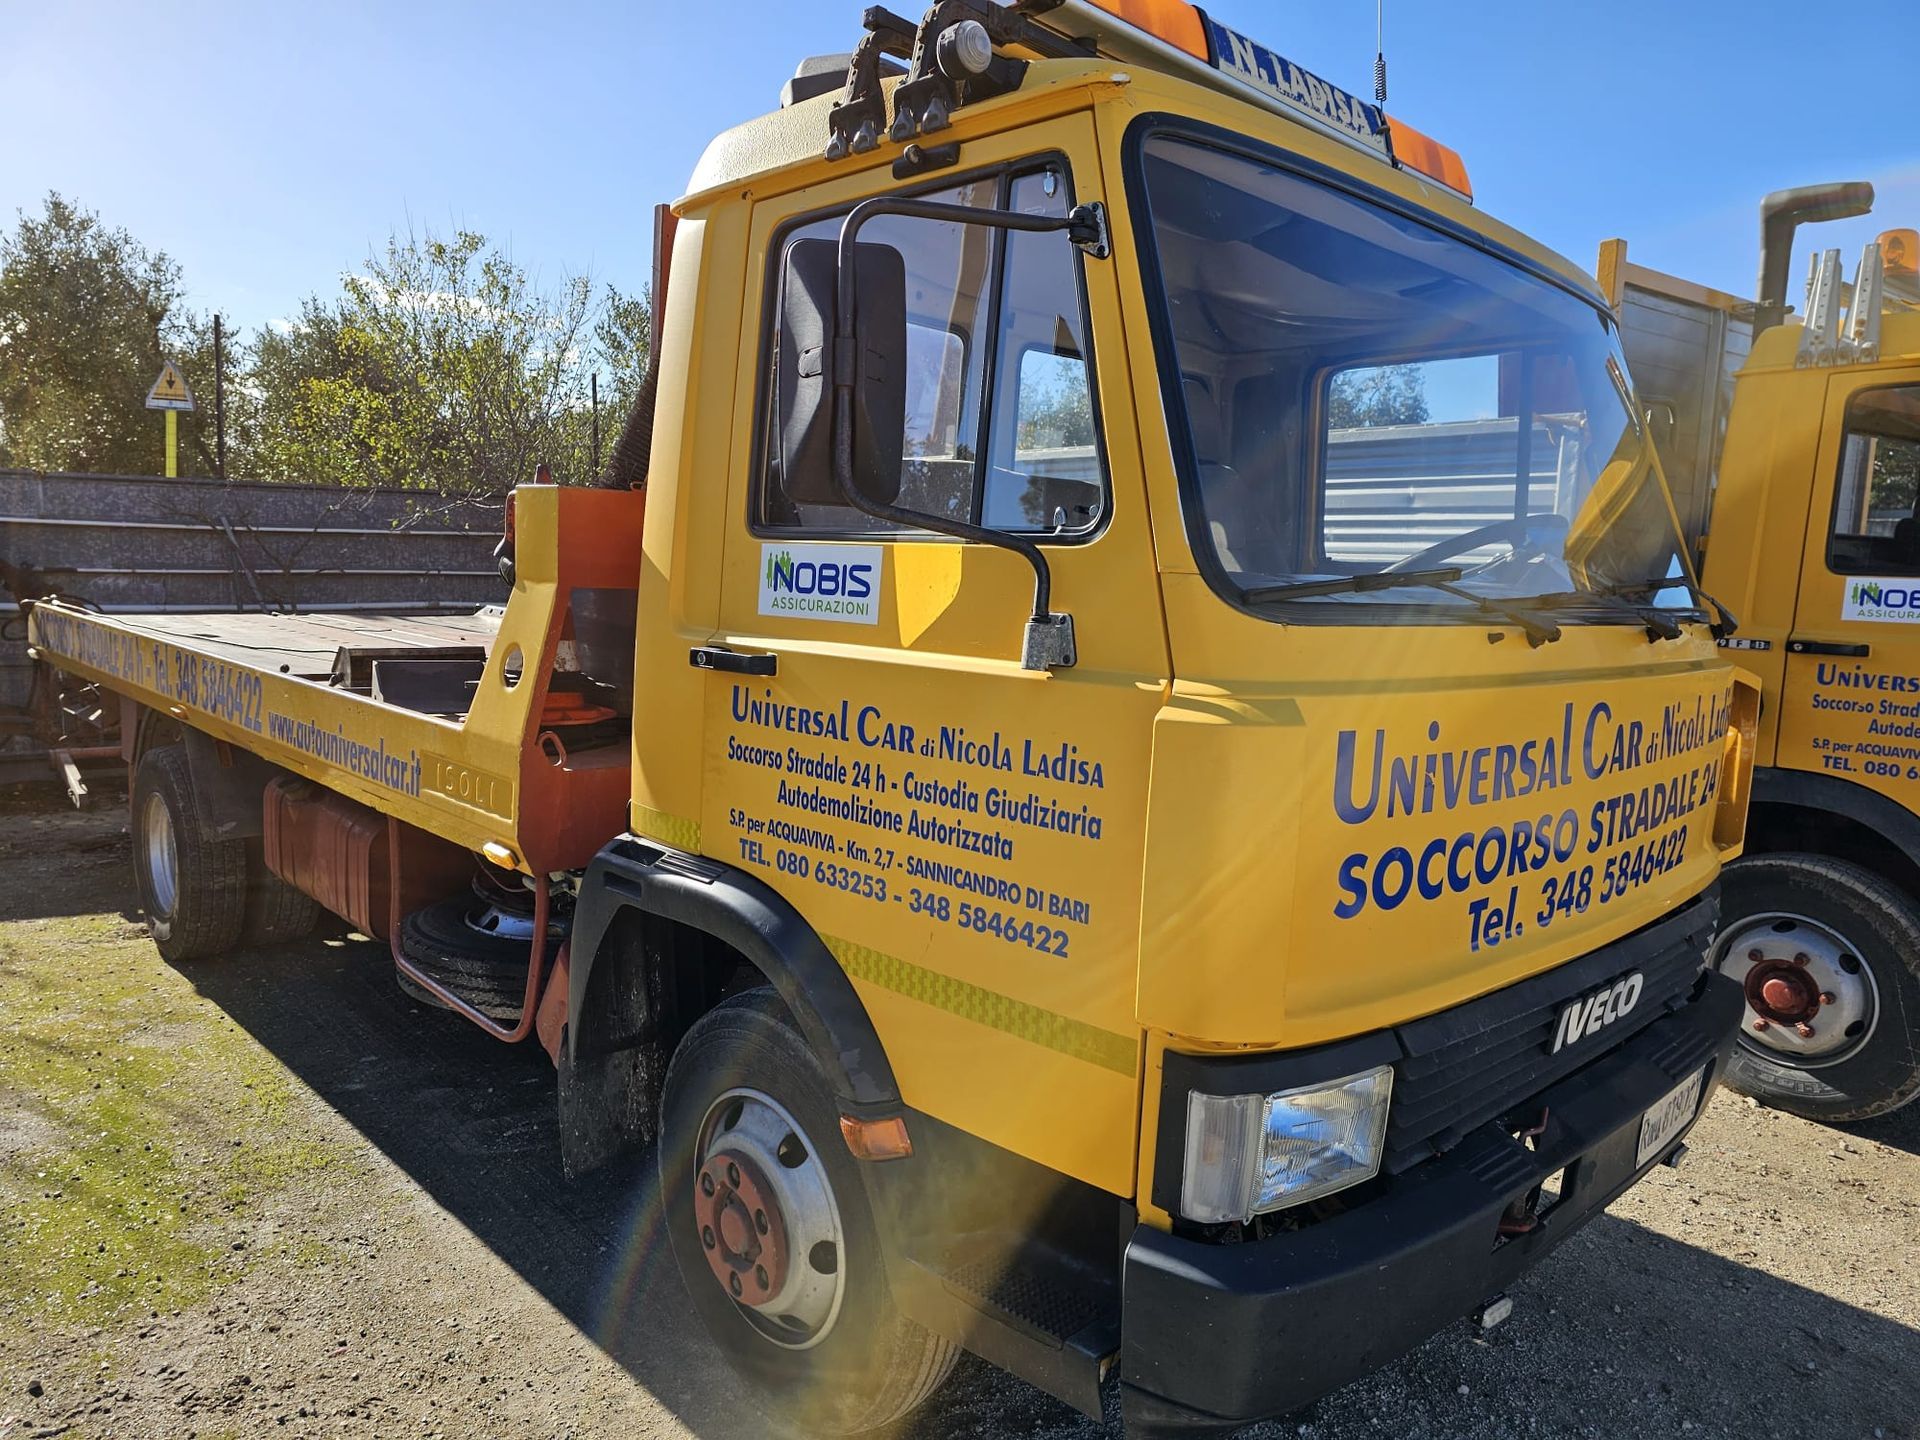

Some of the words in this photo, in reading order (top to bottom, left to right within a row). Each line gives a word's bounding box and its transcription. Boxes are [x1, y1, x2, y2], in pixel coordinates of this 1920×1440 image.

[1269, 53, 1373, 134] LADISA
[771, 597, 869, 616] ASSICURAZIONI
[774, 561, 872, 598] NOBIS
[176, 651, 198, 706] 348
[201, 658, 262, 734] 5846422
[1812, 694, 1874, 713] Soccorso
[268, 712, 421, 798] www.autouniversalcar.it
[436, 763, 494, 808] ISOLI
[920, 737, 935, 759] di
[1646, 732, 1659, 764] di
[1812, 738, 1830, 750] S.P.
[1833, 742, 1853, 753] per
[1822, 755, 1857, 772] TEL.
[1864, 761, 1900, 777] 080
[728, 735, 782, 771] Soccorso
[787, 748, 847, 784] Stradale
[851, 760, 871, 789] 24
[875, 768, 886, 793] h
[903, 771, 979, 814] Custodia
[984, 787, 1102, 839] Giudiziaria
[777, 779, 903, 833] Autodemolizione
[907, 810, 1014, 860] Autorizzata
[729, 808, 745, 829] S.P.
[747, 817, 766, 837] per
[767, 820, 836, 854] ACQUAVIVA
[846, 840, 871, 864] Km.
[874, 847, 895, 871] 2,7
[906, 855, 1021, 905] SANNICANDRO
[1026, 887, 1045, 911] DI
[1049, 894, 1090, 925] BARI
[1333, 808, 1580, 919] SOCCORSO
[1586, 768, 1700, 854] STRADALE
[1699, 759, 1719, 806] 24
[739, 838, 770, 868] TEL.
[776, 850, 809, 879] 080
[814, 860, 888, 902] 633253
[909, 888, 950, 922] 348
[957, 902, 1070, 958] 5846422
[1469, 886, 1523, 952] Tel.
[1537, 865, 1592, 928] 348
[1600, 825, 1687, 903] 5846422
[1553, 972, 1644, 1054] IVECO
